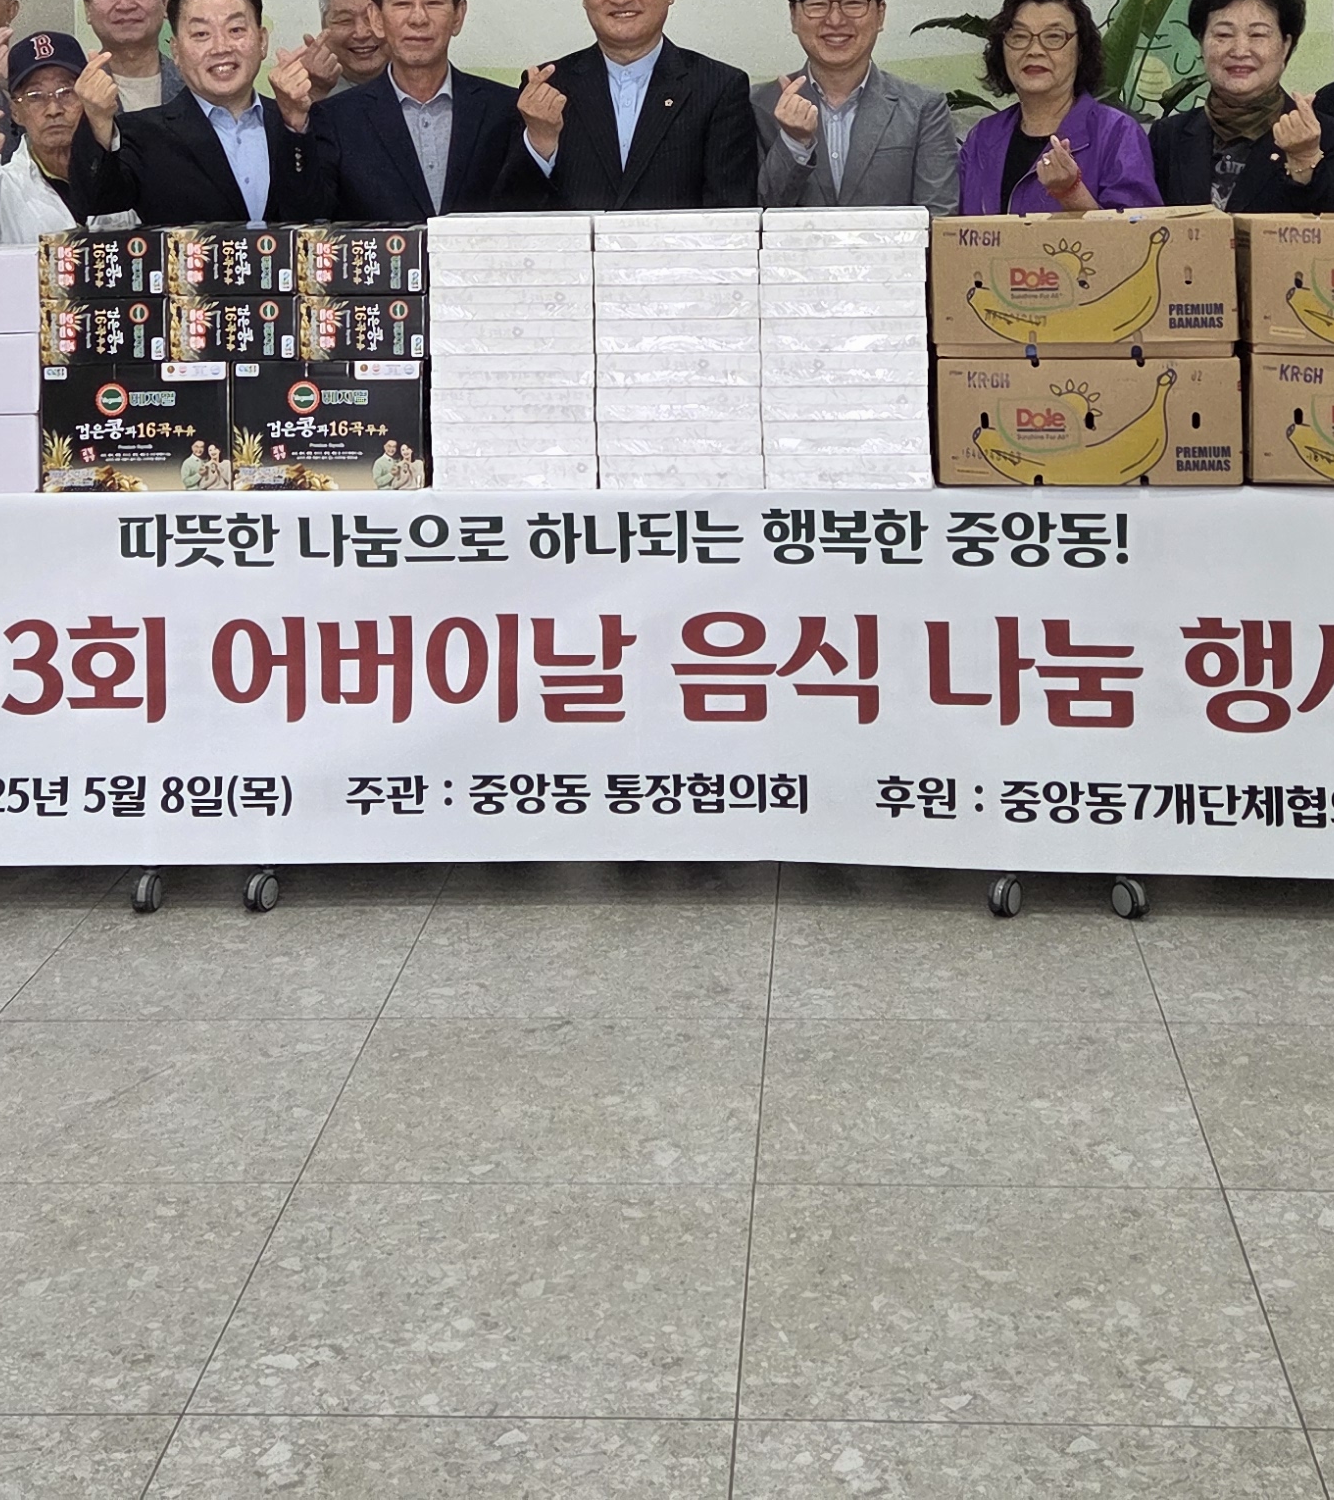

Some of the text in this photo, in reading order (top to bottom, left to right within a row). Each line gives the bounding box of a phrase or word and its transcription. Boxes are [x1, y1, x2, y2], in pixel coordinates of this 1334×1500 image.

[29, 33, 55, 60] B
[1010, 267, 1059, 287] Dole
[1169, 303, 1224, 316] PREMIUM
[1169, 316, 1224, 329] BANANAS
[1017, 408, 1066, 429] Dole
[1175, 446, 1231, 459] PREMIUM
[1176, 459, 1231, 472] BANANAS
[118, 508, 1130, 569] 따뜻한 나눔으로 하나되는 행복한 중앙동!
[210, 612, 637, 724] 어버이날
[670, 610, 880, 726] 음식
[925, 615, 1145, 730] 나눔
[83, 775, 147, 818] 5월
[160, 774, 293, 818] 8일(목)
[346, 775, 428, 817] 주관
[468, 774, 592, 816] 중앙동
[604, 772, 809, 816] 통장협의회
[875, 775, 957, 820] 후원
